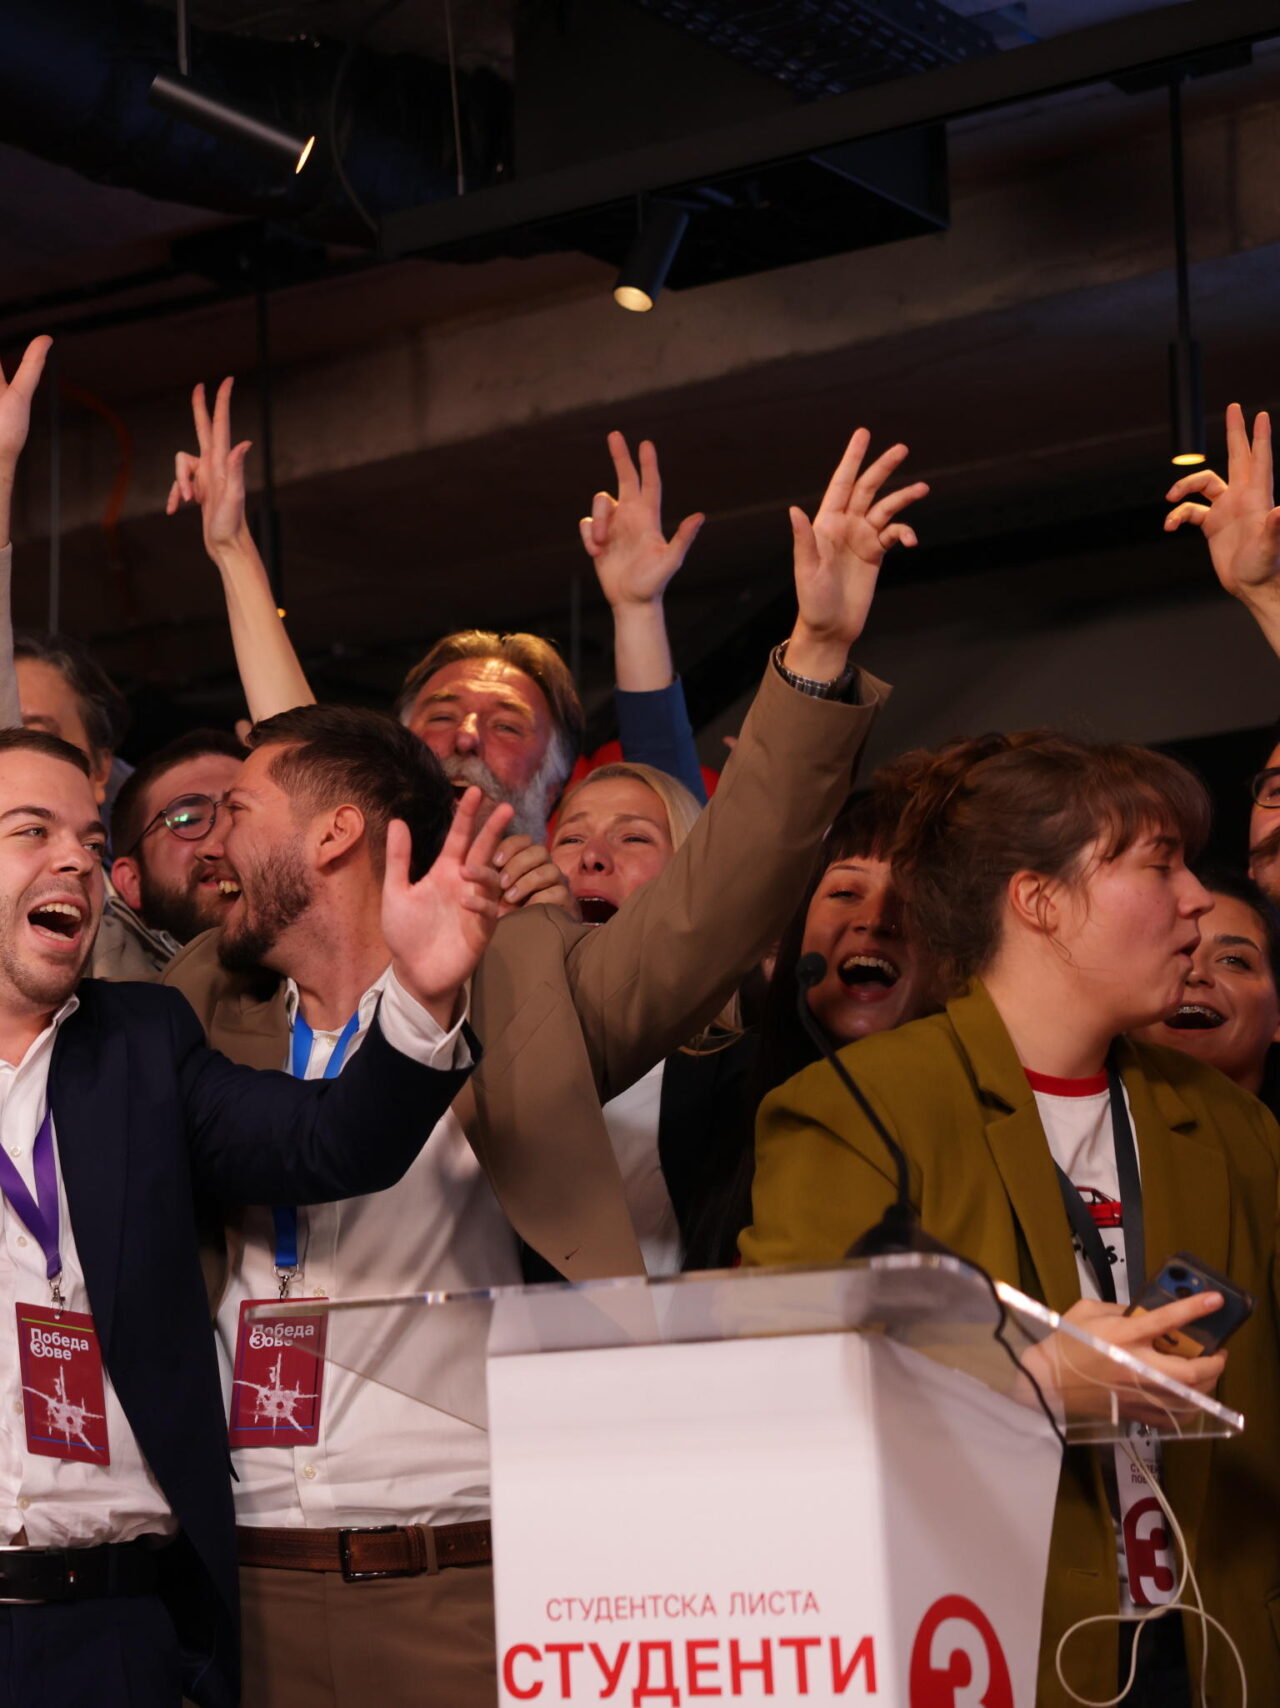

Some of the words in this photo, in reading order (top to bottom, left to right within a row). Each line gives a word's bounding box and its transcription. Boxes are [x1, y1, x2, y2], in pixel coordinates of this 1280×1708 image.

[30, 1327, 89, 1351] Победа
[545, 1592, 718, 1624] СТУДЕНТСКА
[728, 1590, 821, 1617] ЛИСТА
[502, 1634, 878, 1708] СТУДЕНТИ
